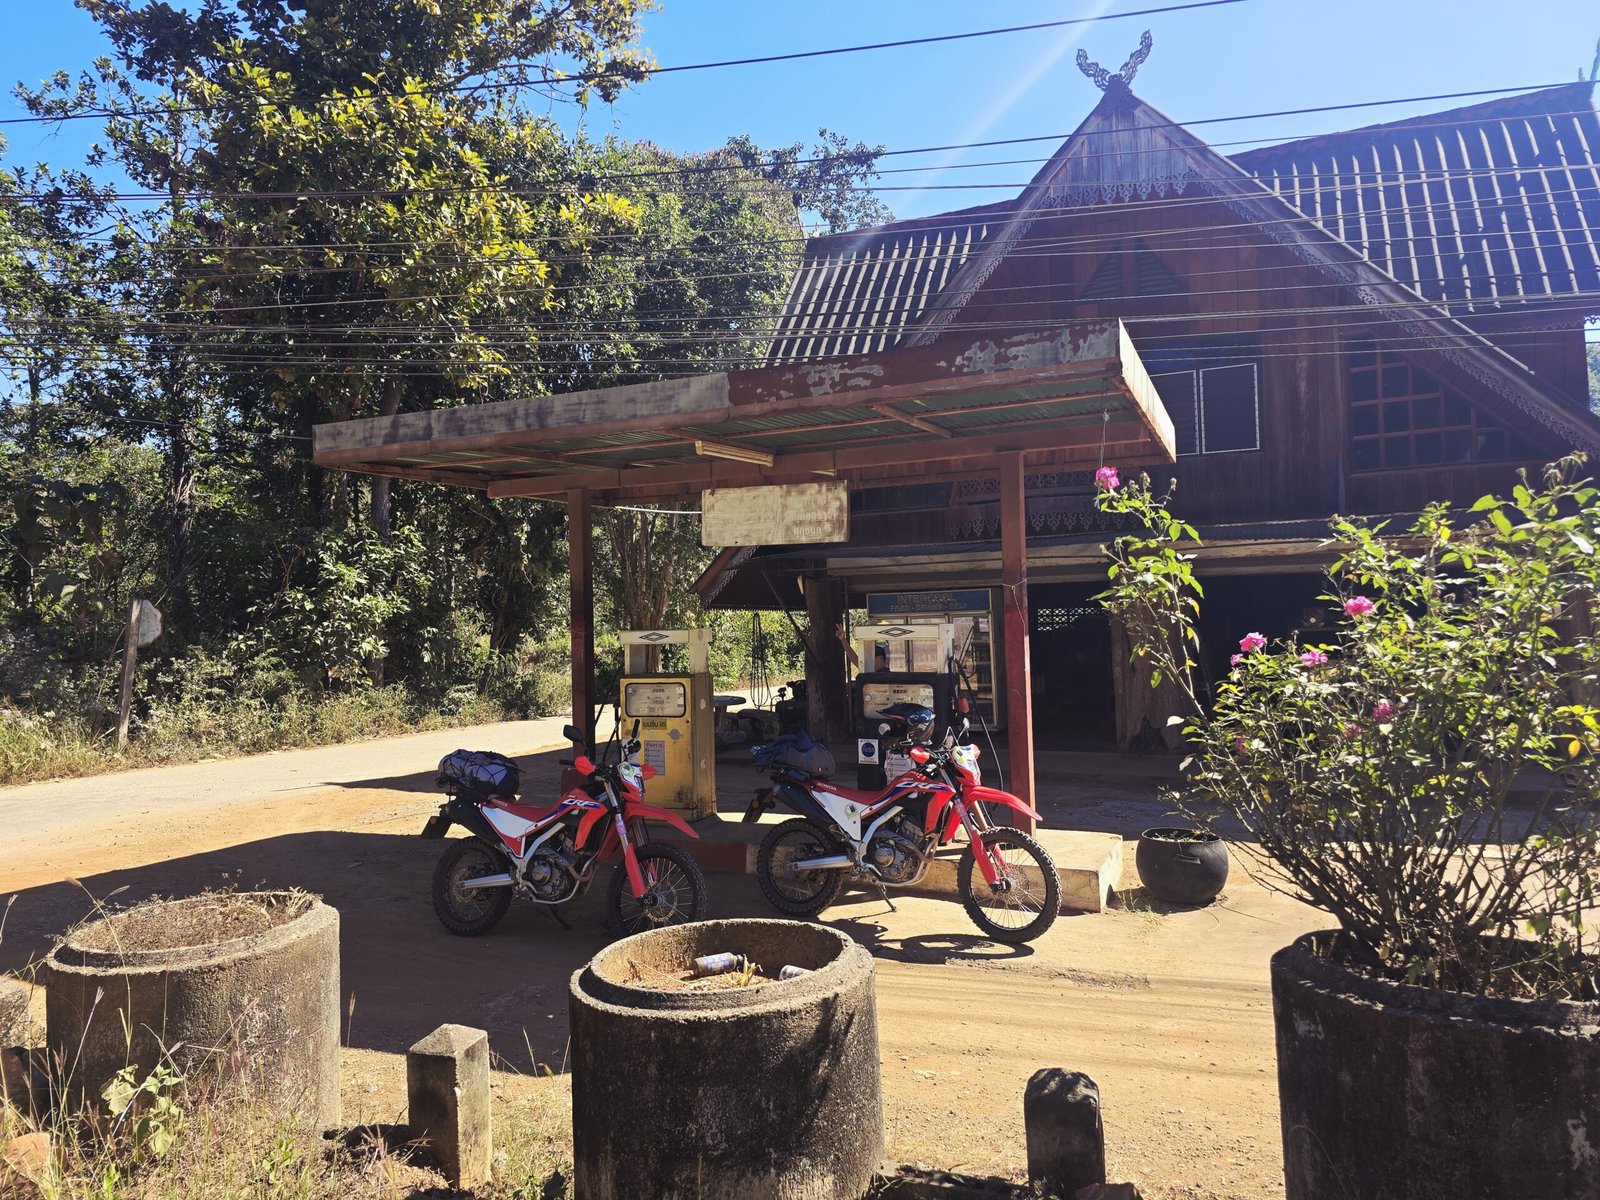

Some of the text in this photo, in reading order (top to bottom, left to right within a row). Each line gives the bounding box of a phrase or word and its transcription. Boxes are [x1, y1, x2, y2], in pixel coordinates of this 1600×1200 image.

[896, 592, 957, 604] INTERCOOL
[816, 781, 837, 791] HONDA
[896, 781, 944, 790] CRF
[562, 798, 599, 807] CRF
